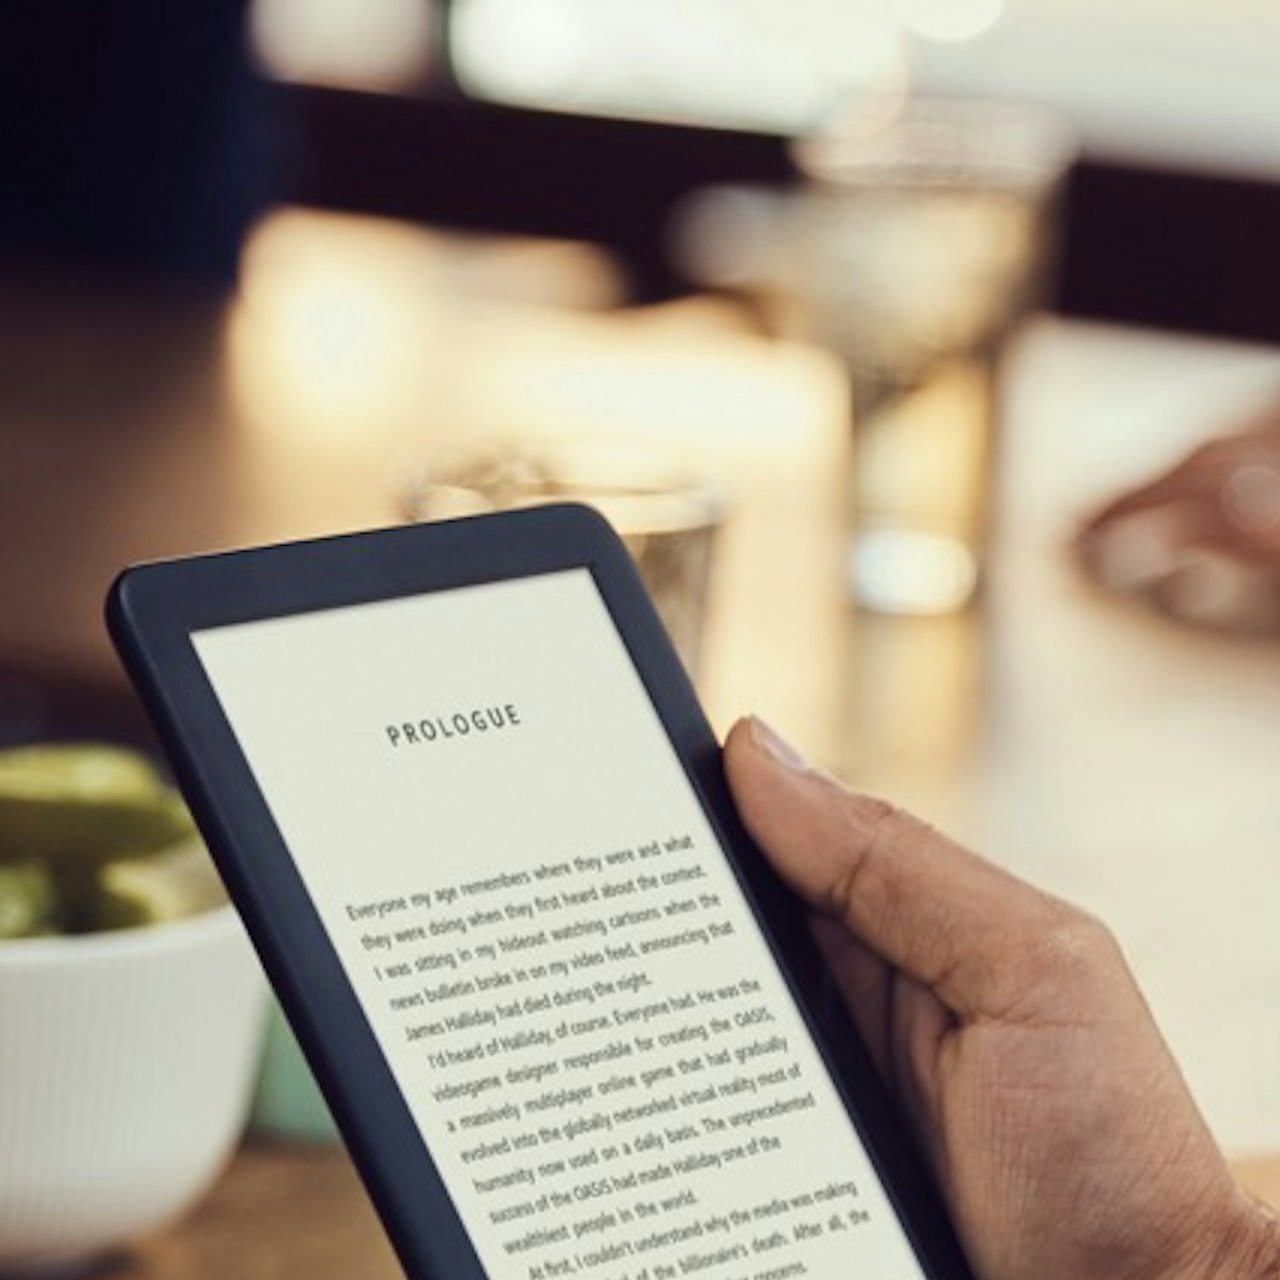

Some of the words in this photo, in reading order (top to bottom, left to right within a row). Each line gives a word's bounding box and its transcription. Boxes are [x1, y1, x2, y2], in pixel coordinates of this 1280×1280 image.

[386, 703, 521, 748] PROLOGUE
[346, 898, 407, 920] Everyone
[410, 894, 430, 907] my
[435, 888, 456, 903] age
[460, 872, 530, 894] remembers
[533, 864, 571, 879] where
[574, 857, 601, 871] they
[605, 850, 634, 864] were
[638, 841, 660, 857] and
[664, 836, 693, 851] what
[361, 934, 391, 949] they
[394, 927, 425, 941] were
[429, 918, 466, 935] doing
[467, 910, 503, 926] when
[505, 904, 533, 917] they
[534, 896, 561, 910] first
[561, 887, 598, 904] heard
[601, 880, 636, 897] about
[637, 876, 657, 889] the
[661, 865, 706, 884] contest.
[385, 963, 411, 977] was
[415, 954, 456, 971] sitting
[457, 949, 471, 961] in
[475, 945, 495, 959] my
[497, 931, 547, 951] hideout
[551, 920, 607, 939] watching
[610, 909, 660, 928] cartoons
[664, 900, 696, 914] when
[699, 894, 719, 907] the
[390, 994, 423, 1008] news
[424, 982, 474, 1002] bulletin
[475, 973, 511, 990] broke
[513, 970, 528, 980] in
[529, 966, 546, 978] on
[549, 962, 567, 974] my
[570, 953, 603, 968] video
[604, 943, 637, 959] feed,
[640, 930, 708, 953] announcing
[708, 921, 733, 937] that
[406, 1023, 444, 1040] James
[445, 1010, 495, 1030] Halliday
[496, 1000, 522, 1018] had
[523, 994, 551, 1013] died
[553, 988, 594, 1005] during
[593, 982, 614, 995] the
[616, 974, 651, 992] night.
[445, 1043, 483, 1063] heard
[486, 1038, 498, 1055] of
[499, 1030, 554, 1051] Halliday,
[555, 1022, 567, 1037] of
[571, 1017, 611, 1034] course.
[613, 1003, 669, 1024] Everyone
[669, 994, 695, 1009] had.
[697, 992, 715, 1002] He
[716, 986, 739, 998] was
[739, 980, 760, 993] the
[432, 1076, 501, 1100] videogame
[506, 1062, 557, 1082] designer
[563, 1042, 631, 1068] responsible
[634, 1038, 653, 1050] for
[658, 1026, 708, 1045] creating
[709, 1019, 731, 1033] the
[734, 1007, 774, 1026] OASIS,
[460, 1103, 519, 1127] massively
[524, 1086, 592, 1111] multiplayer
[598, 1076, 636, 1094] online
[640, 1066, 674, 1087] game
[677, 1058, 703, 1073] that
[705, 1049, 730, 1065] had
[734, 1037, 786, 1063] gradually
[460, 1137, 510, 1163] evolved
[512, 1134, 537, 1148] into
[538, 1128, 561, 1142] the
[562, 1113, 611, 1139] globally
[613, 1095, 677, 1122] networked
[679, 1085, 717, 1105] virtual
[718, 1078, 756, 1095] reality
[757, 1069, 786, 1085] most
[788, 1063, 800, 1078] of
[472, 1169, 534, 1192] humanity
[538, 1161, 564, 1176] now
[569, 1148, 598, 1168] used
[601, 1147, 618, 1159] on
[634, 1133, 663, 1151] daily
[664, 1127, 698, 1142] basis.
[701, 1118, 725, 1131] The
[729, 1092, 814, 1126] unprecedented
[489, 1203, 534, 1223] success
[535, 1195, 549, 1211] of
[550, 1192, 572, 1206] the
[573, 1179, 612, 1199] OASIS
[611, 1172, 636, 1190] had
[638, 1165, 672, 1183] made
[673, 1153, 720, 1173] Halliday
[721, 1147, 745, 1160] one
[746, 1138, 758, 1154] of
[760, 1137, 780, 1150] the
[503, 1225, 570, 1253] wealthiest
[573, 1212, 615, 1238] people
[617, 1209, 632, 1222] in
[634, 1203, 657, 1217] the
[661, 1190, 697, 1210] world.
[529, 1267, 544, 1280] At
[544, 1259, 575, 1275] first,
[583, 1242, 633, 1266] couldn't
[635, 1221, 702, 1251] understand
[704, 1217, 729, 1231] why
[730, 1211, 750, 1224] the
[753, 1200, 789, 1217] media
[790, 1195, 813, 1207] was
[814, 1182, 857, 1201] making
[653, 1266, 675, 1280] the
[678, 1245, 747, 1273] billionaire's
[752, 1232, 787, 1252] death.
[793, 1224, 822, 1240] After
[828, 1215, 846, 1230] all,
[848, 1210, 869, 1224] the
